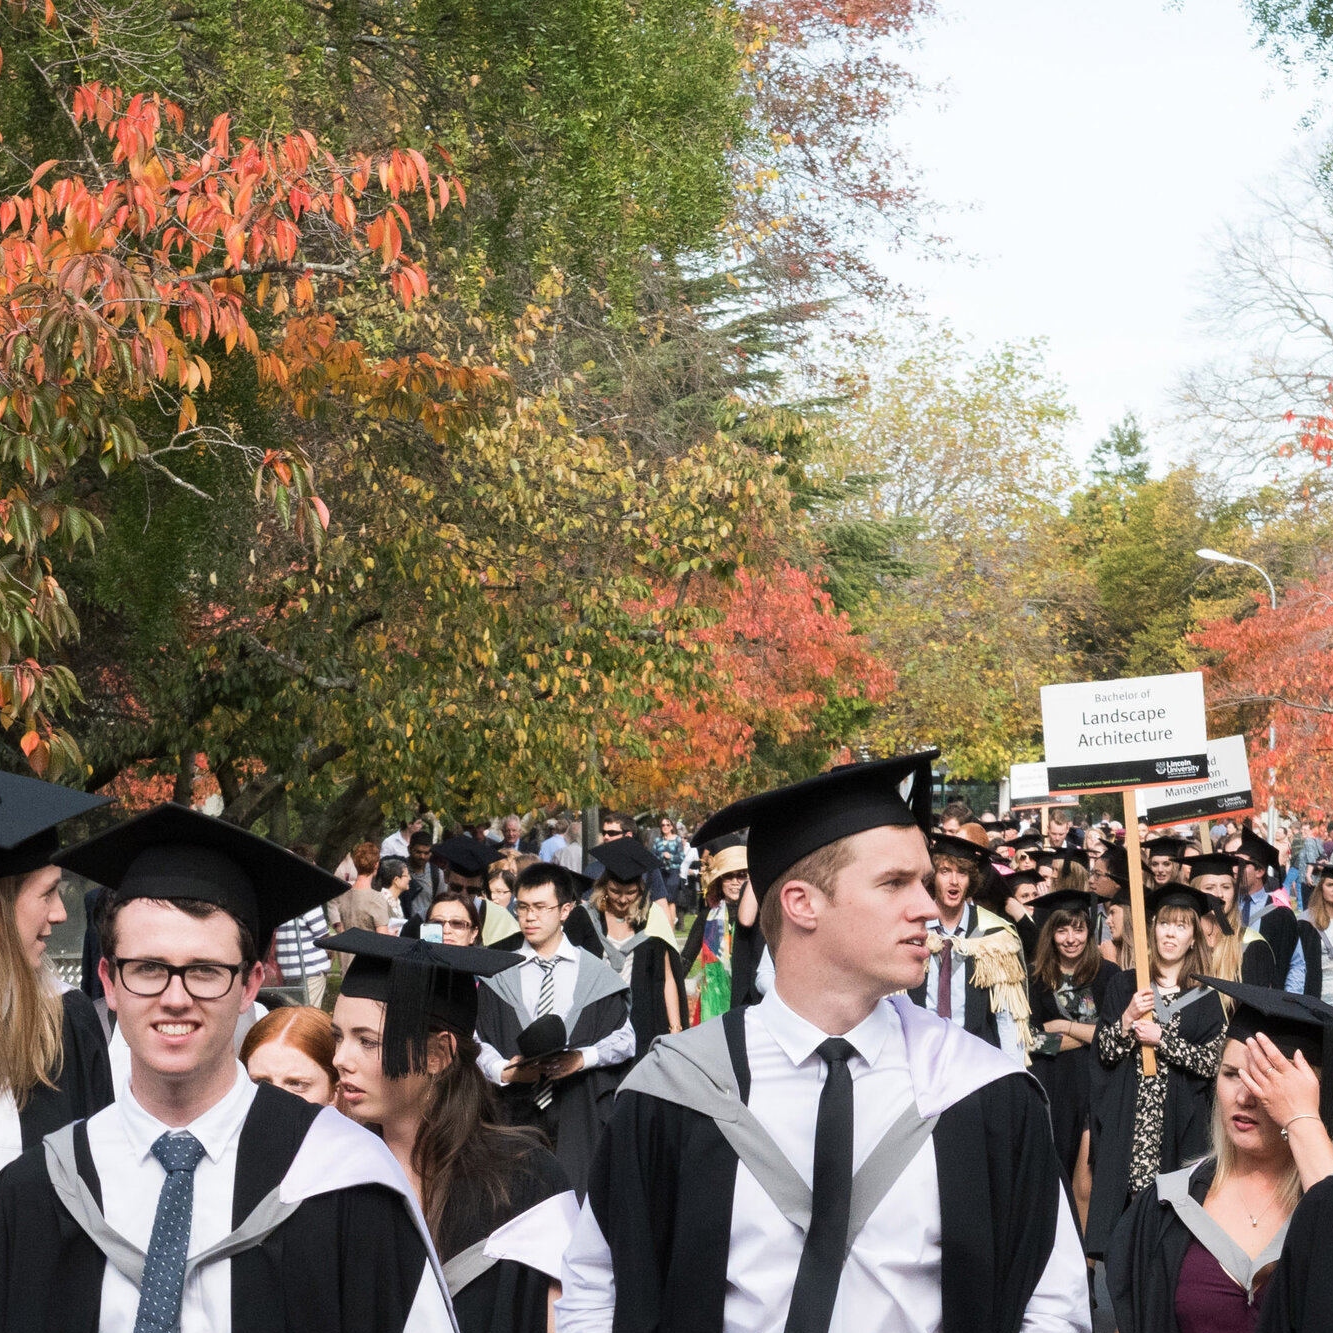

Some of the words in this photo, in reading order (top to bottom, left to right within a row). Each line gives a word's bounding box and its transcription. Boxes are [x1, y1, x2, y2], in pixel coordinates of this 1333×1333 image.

[1095, 690, 1138, 703] Bachelor
[1141, 689, 1151, 699] of
[1082, 707, 1166, 726] Landscape
[1078, 729, 1173, 748] Architecture
[1166, 759, 1192, 768] Lincoln
[1167, 765, 1200, 774] University
[1165, 778, 1229, 798] Management
